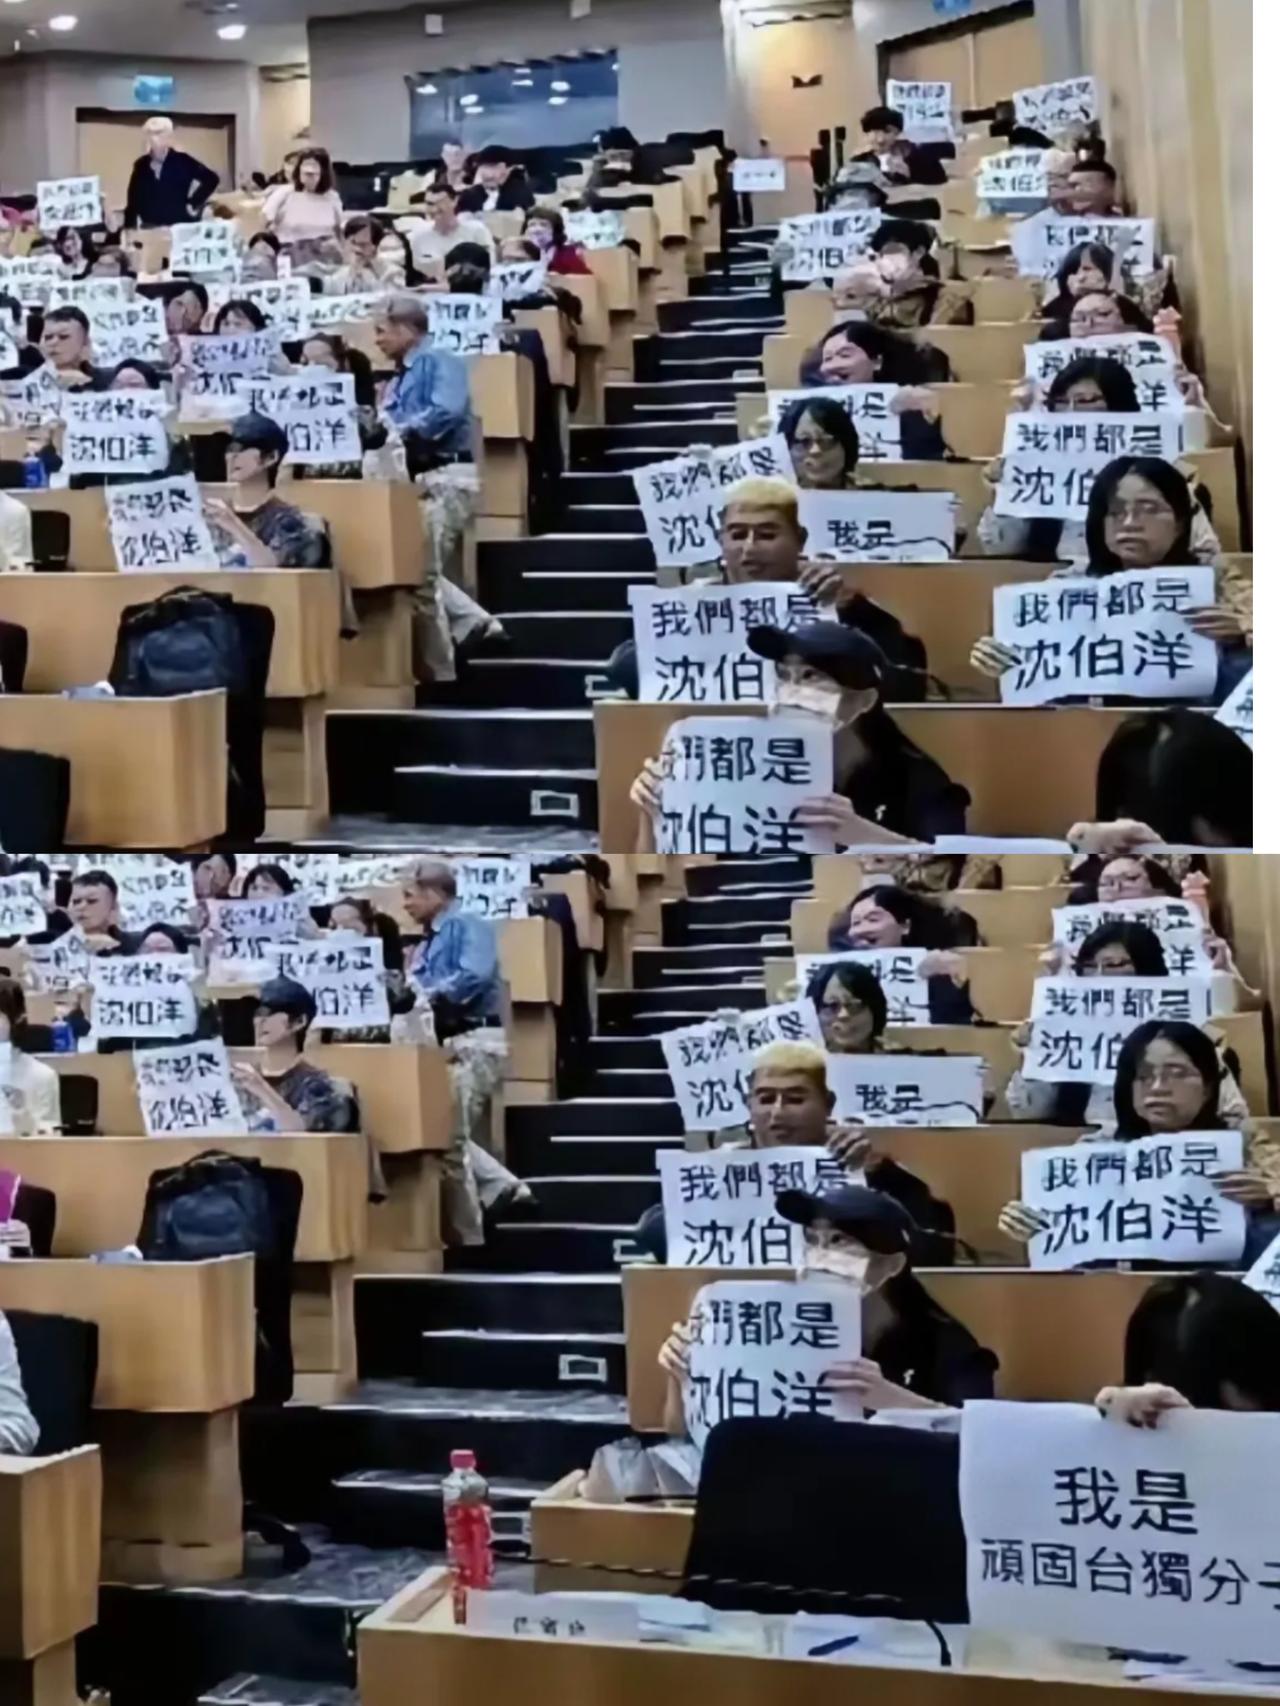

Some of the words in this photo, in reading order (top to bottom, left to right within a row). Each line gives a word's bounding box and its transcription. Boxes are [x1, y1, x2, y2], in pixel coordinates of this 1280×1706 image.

[1016, 423, 1162, 455] 我們都是
[1013, 577, 1190, 628] 我們都是
[1012, 629, 1195, 691] 沈伯洋
[1044, 987, 1190, 1019] 我們都是
[1041, 1141, 1218, 1192] 我們都是
[1040, 1193, 1223, 1255] 沈伯洋
[1054, 1466, 1199, 1535] 我是
